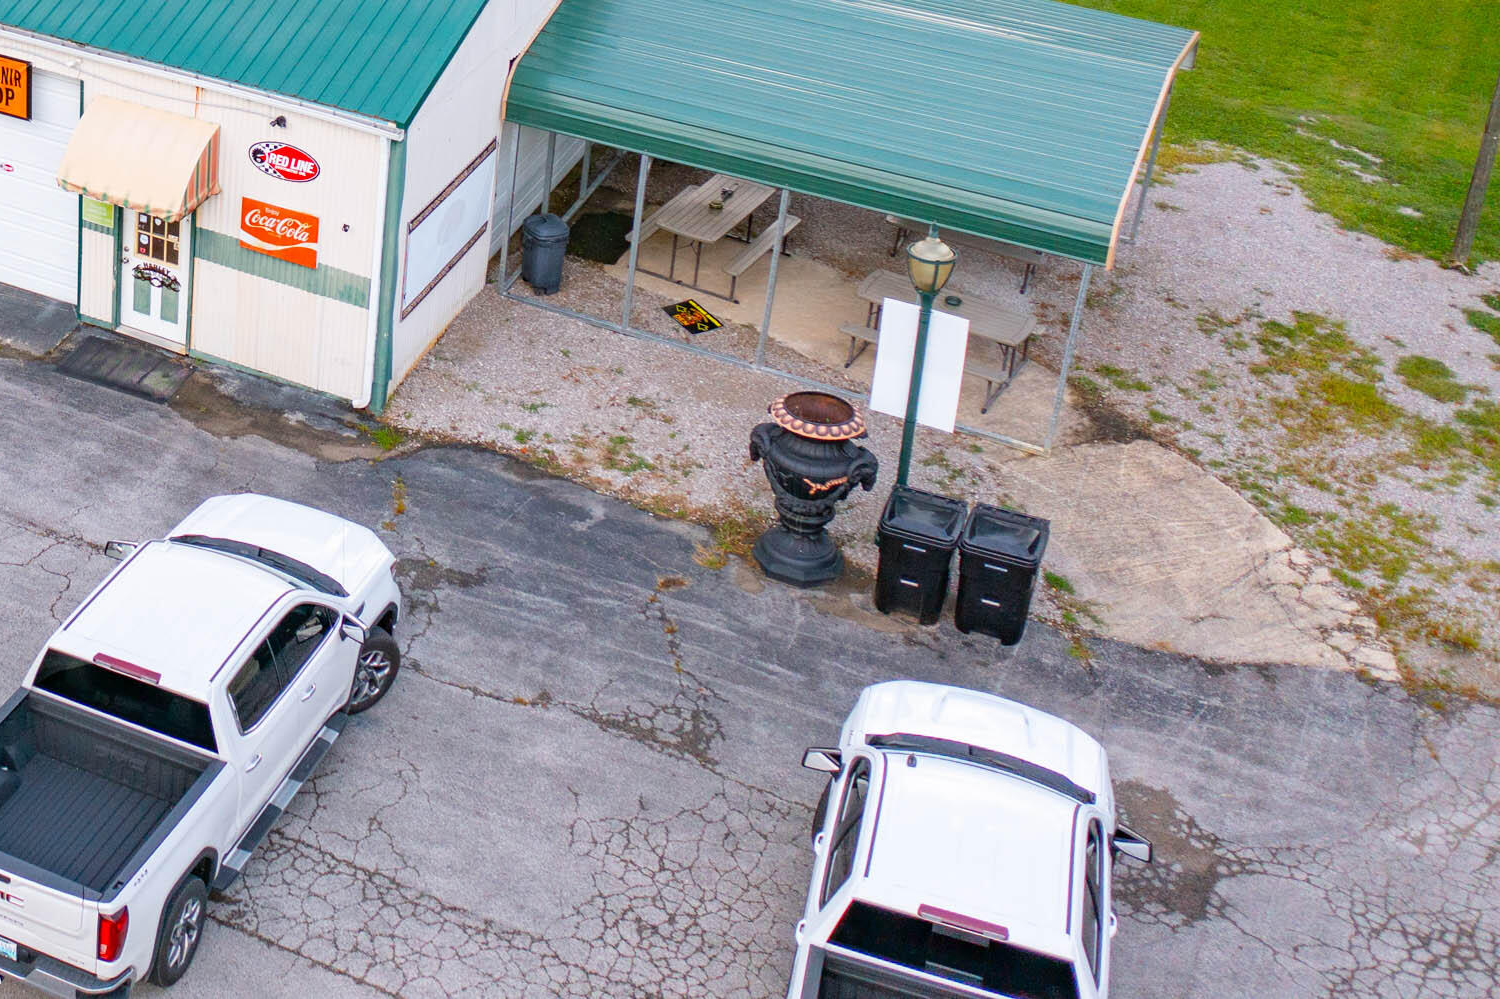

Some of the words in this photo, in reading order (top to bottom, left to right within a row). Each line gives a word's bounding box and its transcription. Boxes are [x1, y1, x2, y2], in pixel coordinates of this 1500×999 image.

[268, 152, 290, 169] RED
[290, 158, 315, 174] LINE
[244, 208, 312, 242] Coca-Cola
